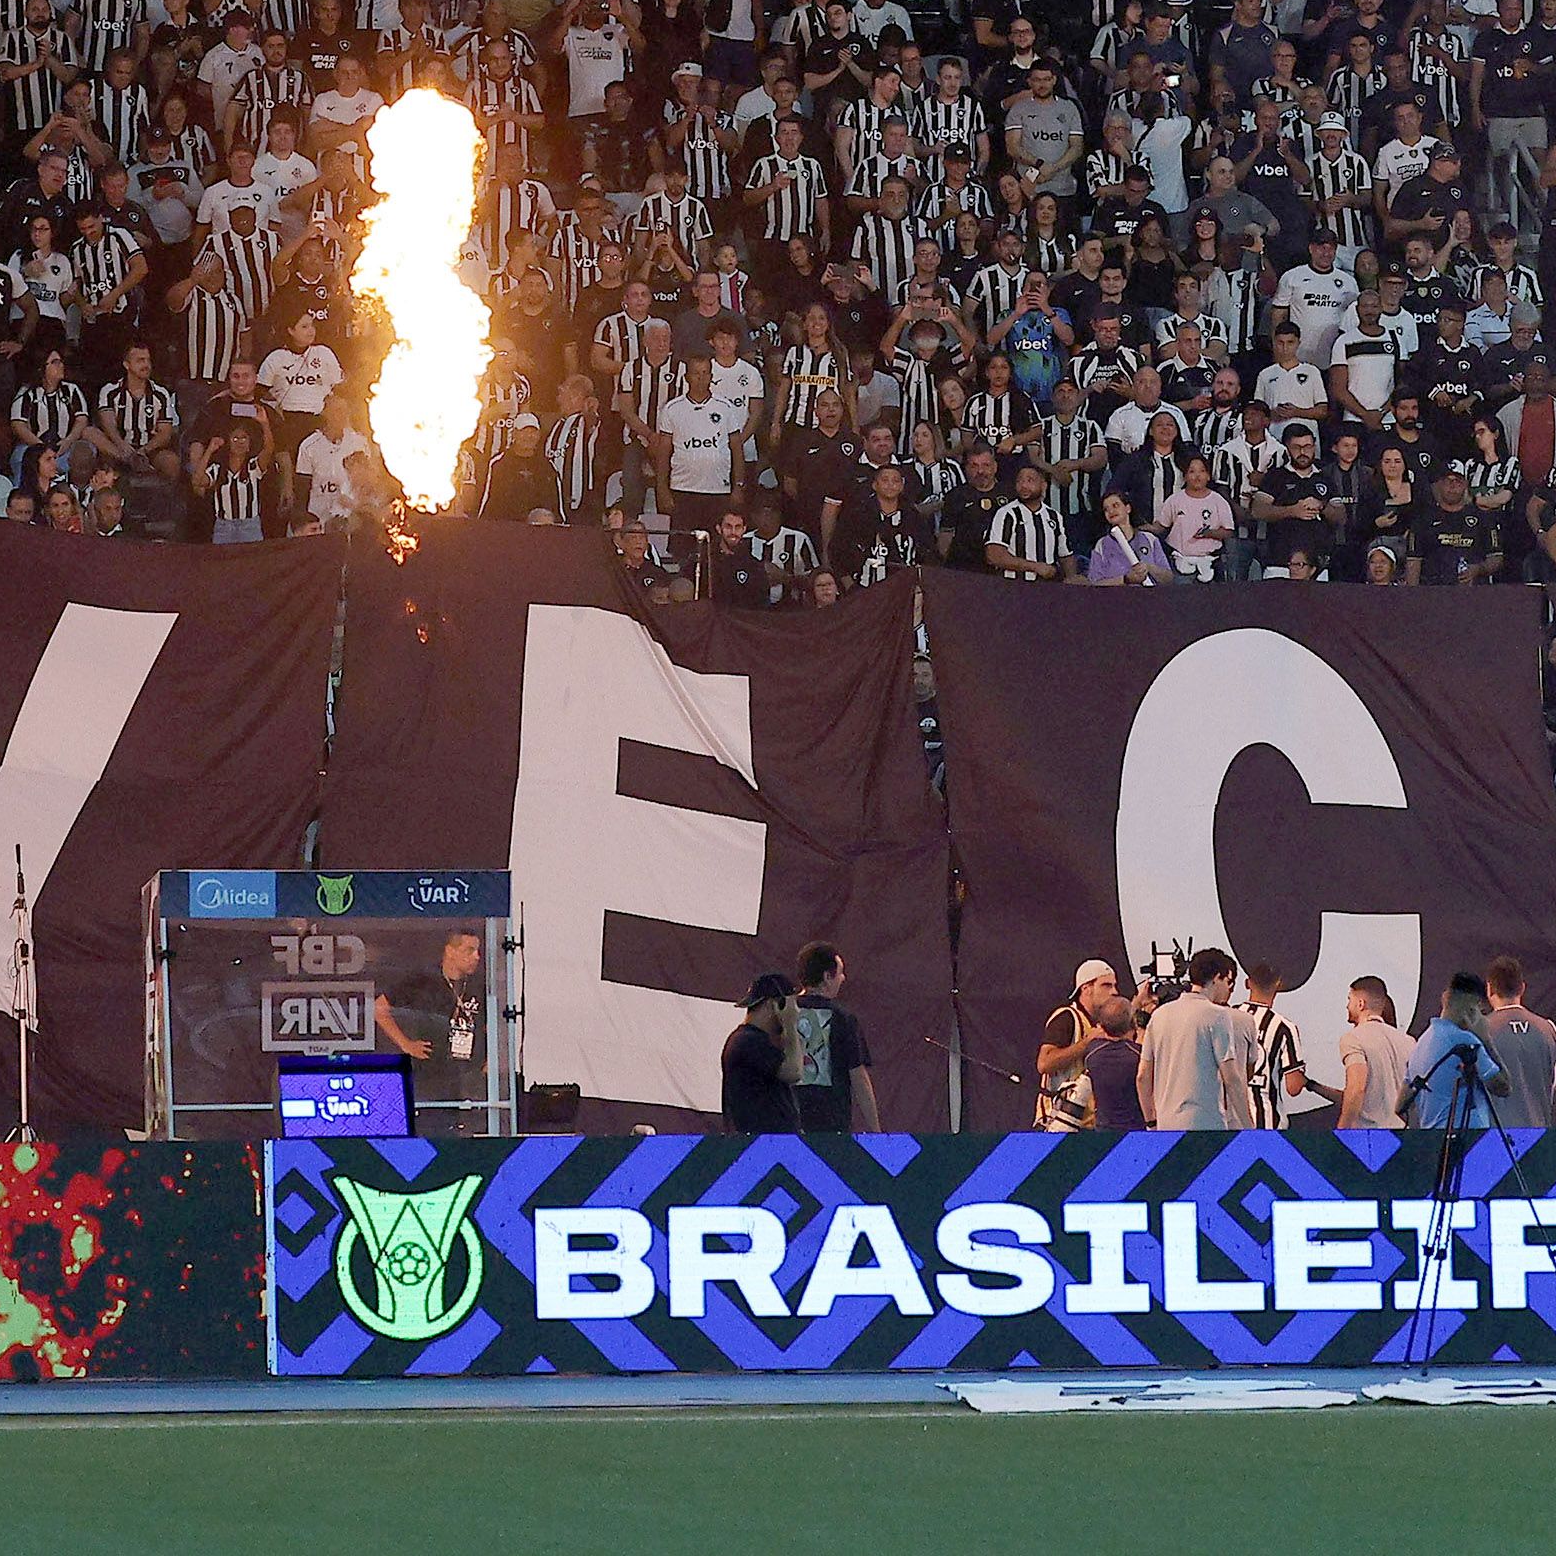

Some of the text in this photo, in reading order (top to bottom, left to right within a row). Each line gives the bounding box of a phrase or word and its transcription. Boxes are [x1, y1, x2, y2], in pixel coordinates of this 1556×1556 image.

[93, 20, 125, 31] vbet
[225, 62, 232, 72] 7
[1419, 64, 1447, 76] vbet
[1496, 66, 1512, 76] vb
[864, 129, 881, 140] vb
[932, 127, 963, 138] vbet
[1032, 131, 1062, 140] vbet
[688, 139, 718, 149] vbet
[1255, 164, 1287, 176] vbet
[69, 175, 81, 184] et
[574, 258, 597, 268] vbe
[653, 292, 678, 301] vbet
[1415, 312, 1436, 323] bet
[1014, 338, 1046, 349] vbet
[1437, 382, 1467, 394] vbet
[732, 397, 746, 406] et
[683, 436, 717, 448] vbet
[320, 481, 336, 492] vb
[870, 545, 887, 556] vb
[210, 890, 269, 907] Midea
[420, 886, 460, 904] VAR
[1510, 1021, 1530, 1034] TV
[328, 1102, 361, 1115] VAR
